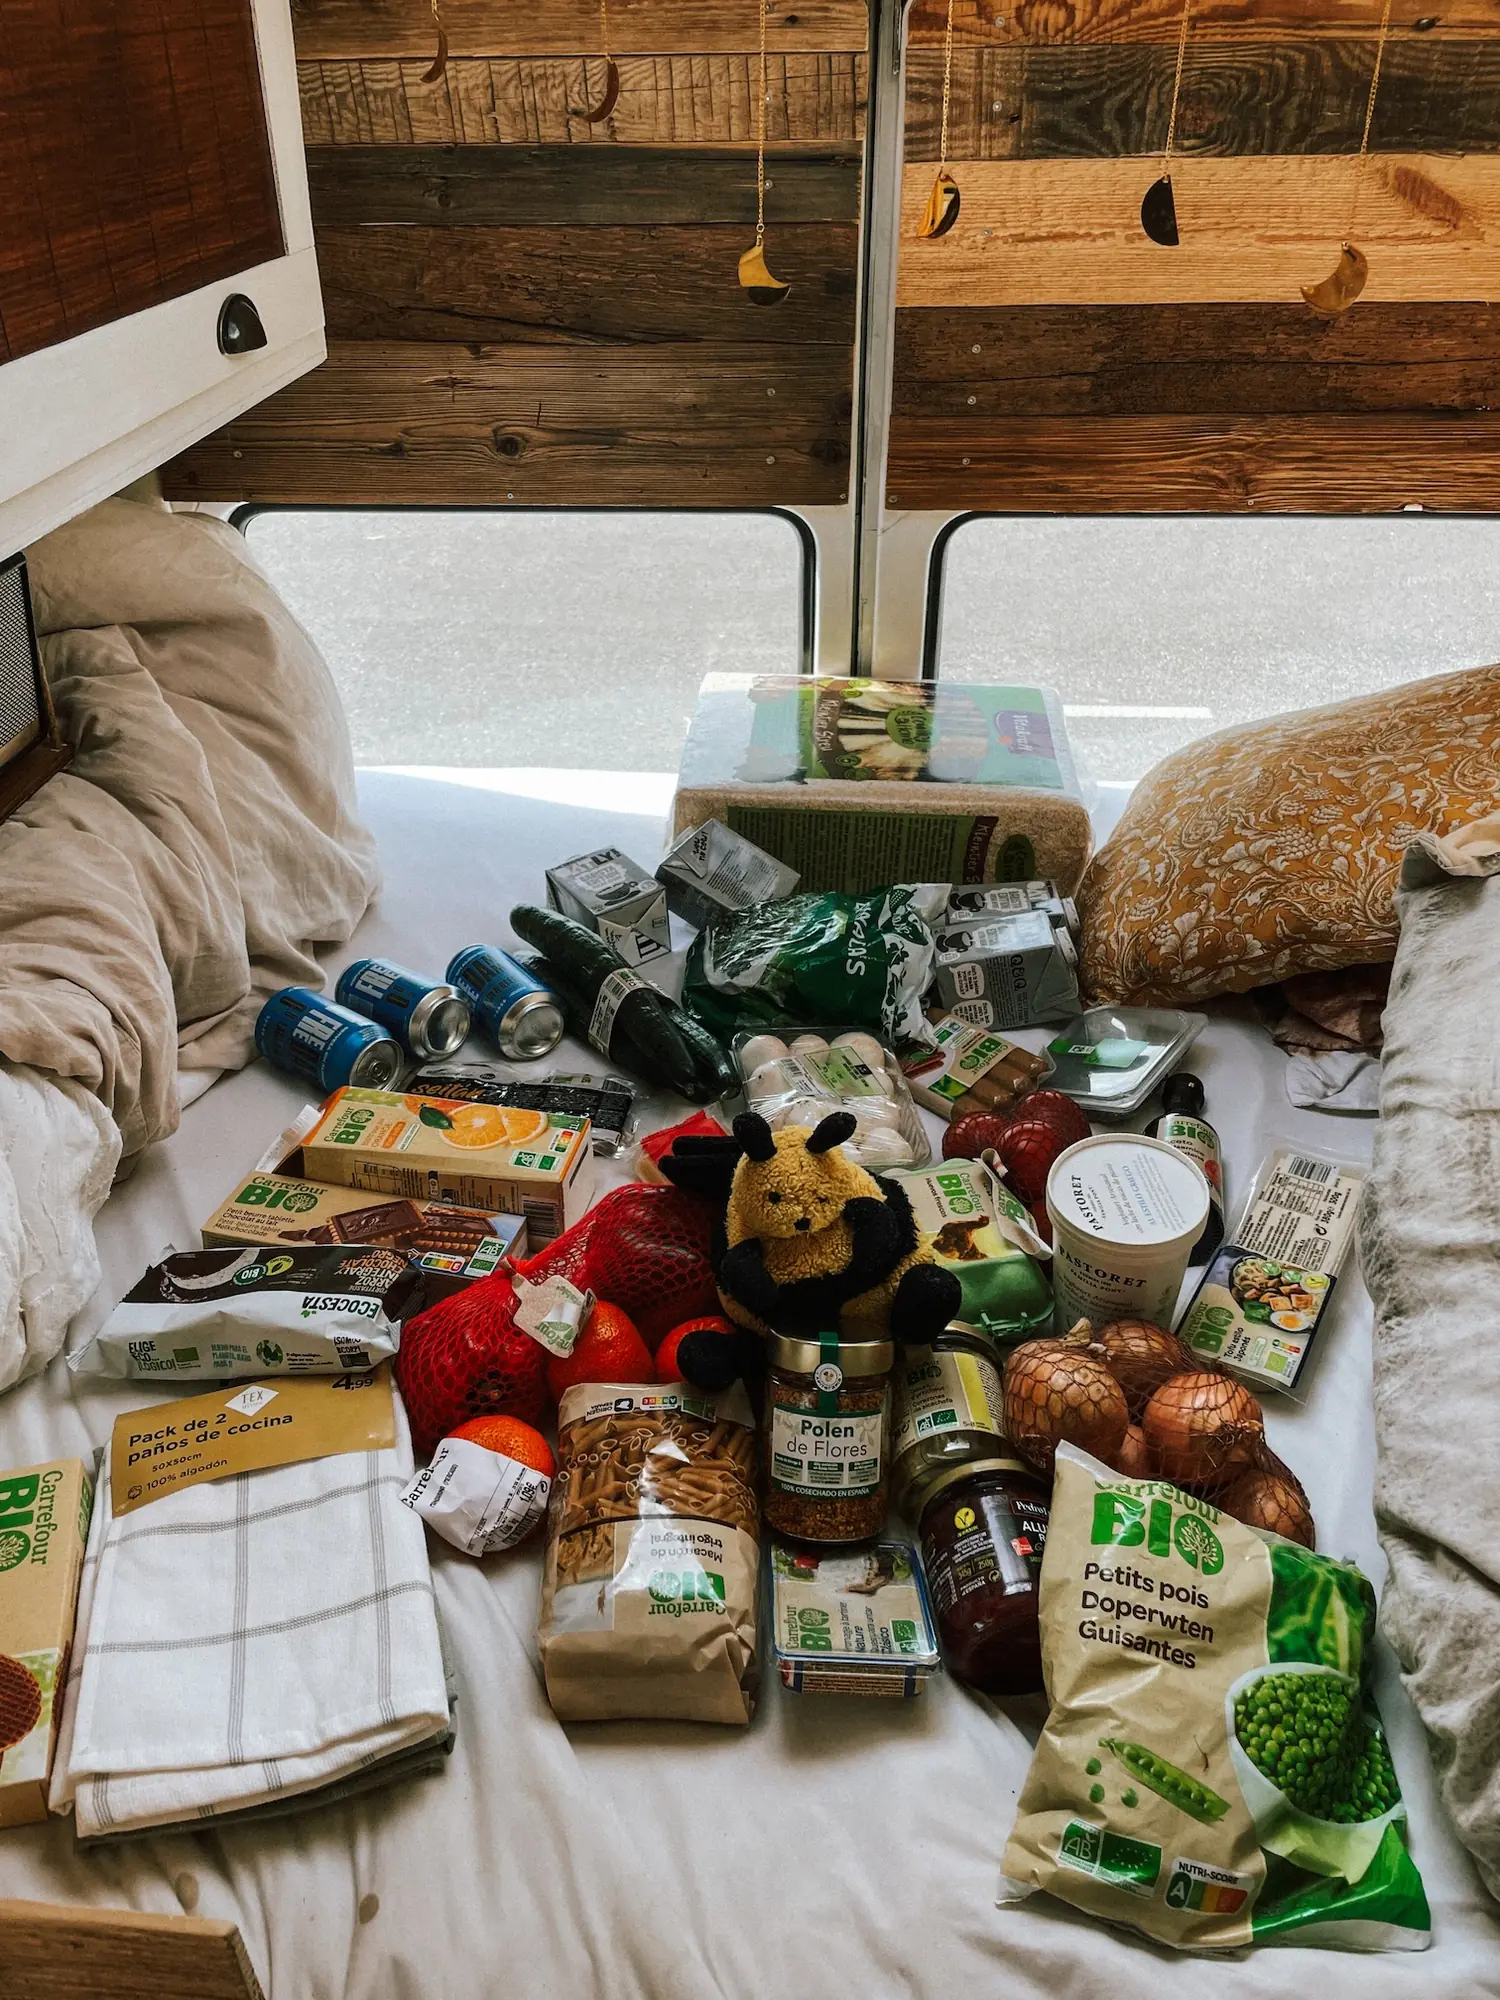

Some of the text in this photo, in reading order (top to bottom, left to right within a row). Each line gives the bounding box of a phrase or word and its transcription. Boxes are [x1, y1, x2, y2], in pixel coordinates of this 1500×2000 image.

[1010, 954, 1027, 991] Q&Q
[960, 1037, 1003, 1071] BIO
[324, 1106, 354, 1144] Carrefour
[333, 1108, 375, 1145] BIO
[235, 1183, 319, 1213] BIO
[252, 1175, 328, 1197] Carrefour
[937, 1174, 974, 1214] BIO
[222, 1212, 256, 1222] Chocolat
[1071, 1174, 1104, 1232] PASTORET
[241, 1267, 260, 1281] BIO
[1058, 1244, 1147, 1288] PASTORET
[355, 1276, 395, 1288] ARROZ
[301, 1296, 380, 1318] ECOCESTA
[1193, 1306, 1235, 1354] BIO
[128, 1340, 156, 1354] ELIGE
[241, 1390, 264, 1404] TEX
[128, 1414, 294, 1466] paños de cocina
[129, 1413, 227, 1447] Pack de 2
[801, 1420, 854, 1438] Polen
[786, 1437, 867, 1457] de Flores
[146, 1459, 229, 1491] 100% algodón
[780, 1482, 869, 1497] 100% COSECHADO EN ESPAÑA
[31, 1470, 63, 1565] Carrefour
[697, 1532, 723, 1548] trigo
[1090, 1492, 1225, 1576] BIO
[650, 1546, 667, 1558] de
[648, 1572, 726, 1602] BIO
[1083, 1561, 1210, 1610] Petits pois
[648, 1601, 726, 1617] Carrefour
[1080, 1590, 1214, 1643] Doperwten
[799, 1607, 832, 1651] BIO
[1078, 1620, 1197, 1669] Guisantes
[1178, 1862, 1239, 1885] NUTRI-SCORE
[1171, 1884, 1187, 1901] A
